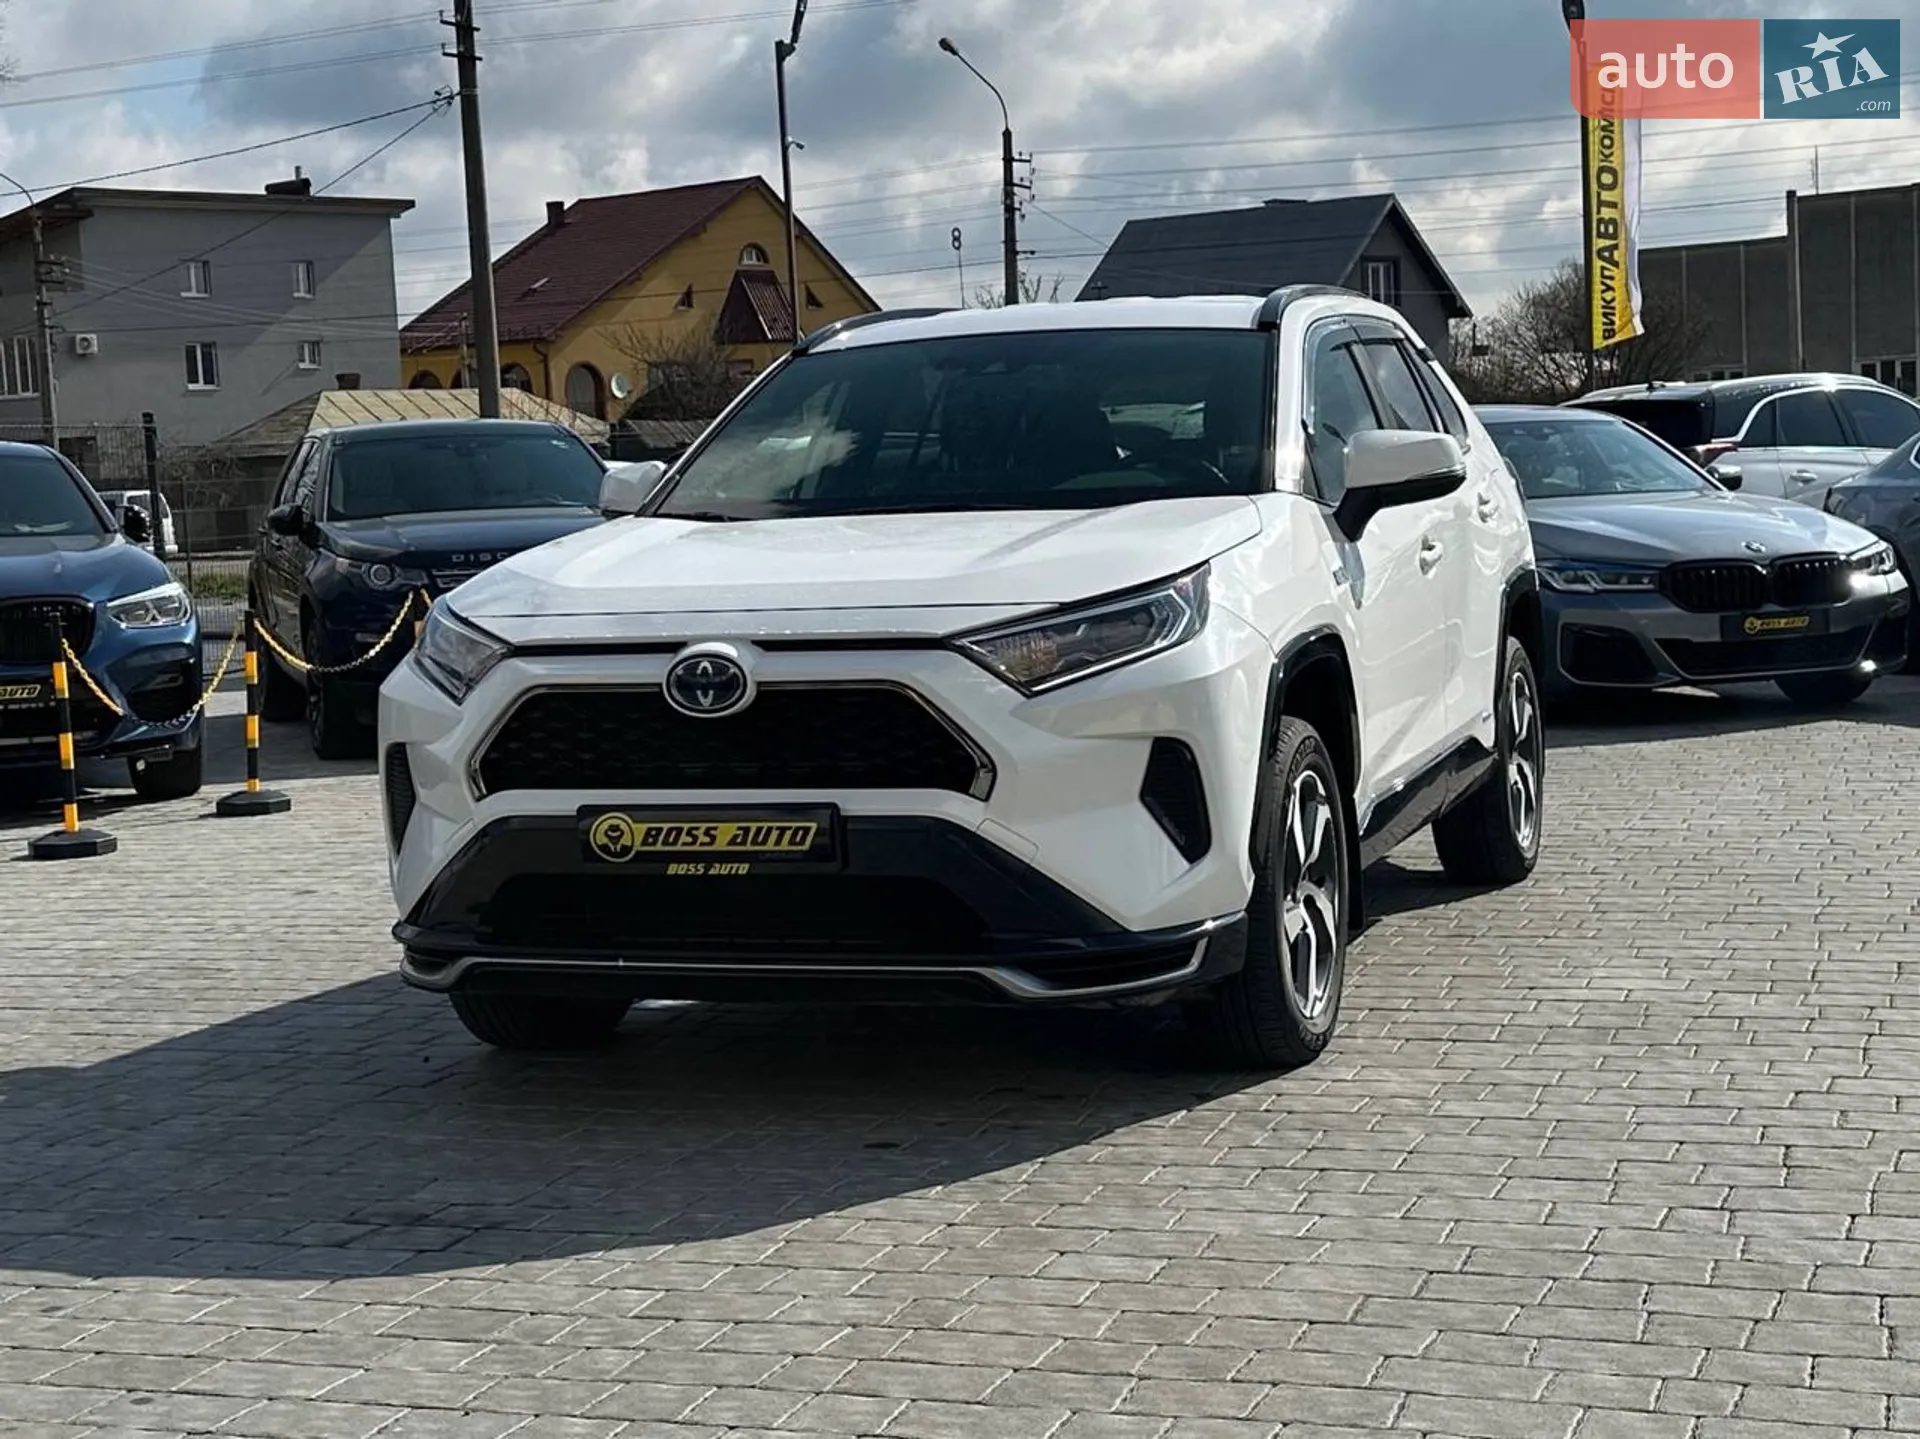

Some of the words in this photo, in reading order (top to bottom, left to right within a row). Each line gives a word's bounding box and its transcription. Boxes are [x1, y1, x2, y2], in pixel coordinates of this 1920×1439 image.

[639, 825, 719, 847] BOSS
[726, 825, 813, 847] AUTO
[666, 863, 706, 875] BOSS
[707, 863, 751, 875] AUTO
